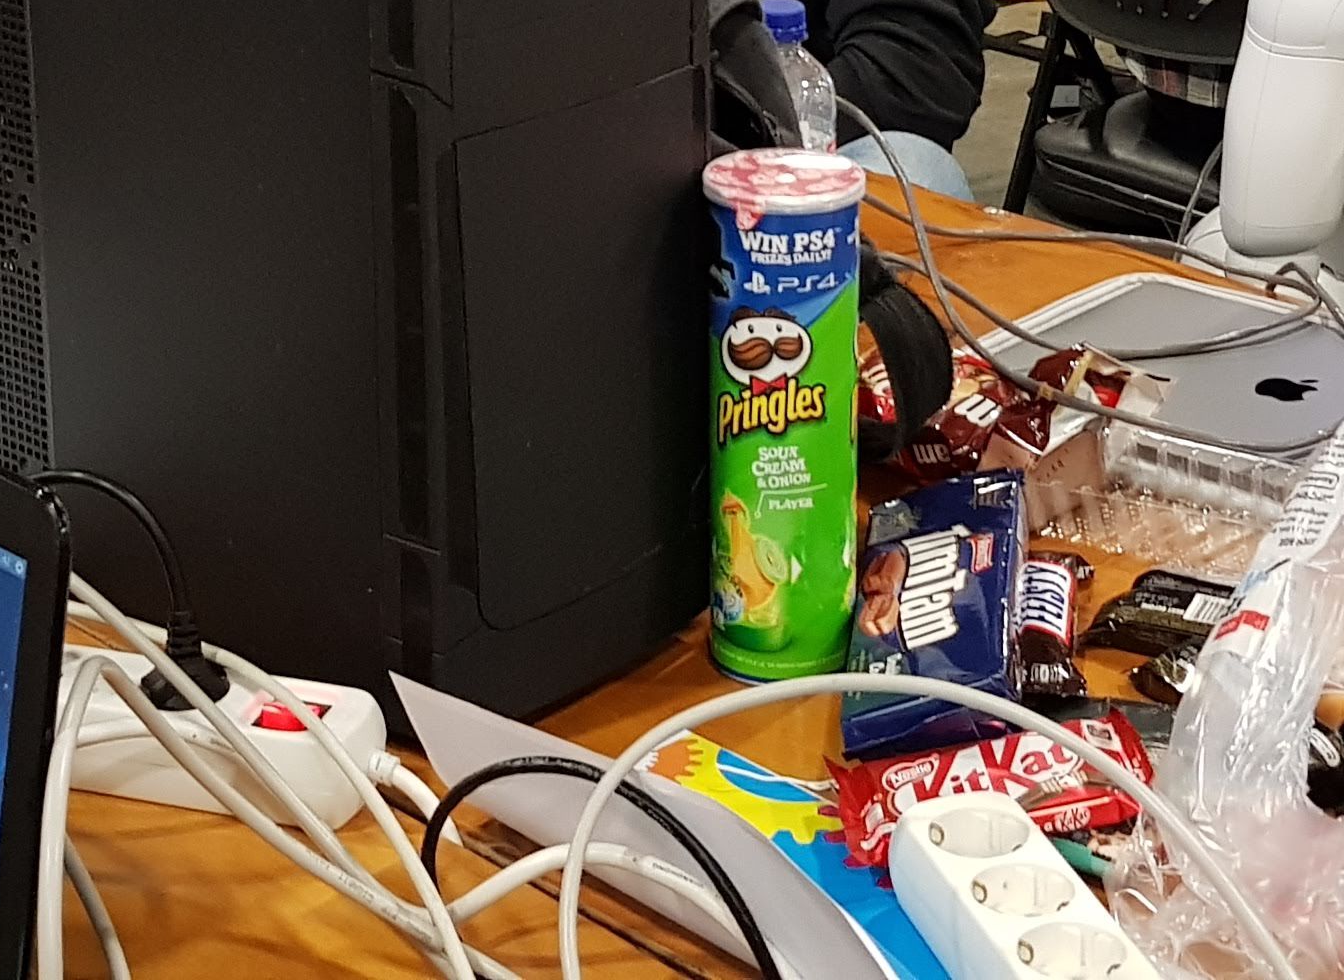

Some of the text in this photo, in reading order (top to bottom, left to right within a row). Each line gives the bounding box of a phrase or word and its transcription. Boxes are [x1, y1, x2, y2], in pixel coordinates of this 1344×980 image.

[738, 230, 789, 254] WIN
[777, 271, 839, 293] PS4
[719, 378, 825, 444] Pringles
[768, 473, 812, 489] ONION
[768, 498, 814, 510] PLAYER
